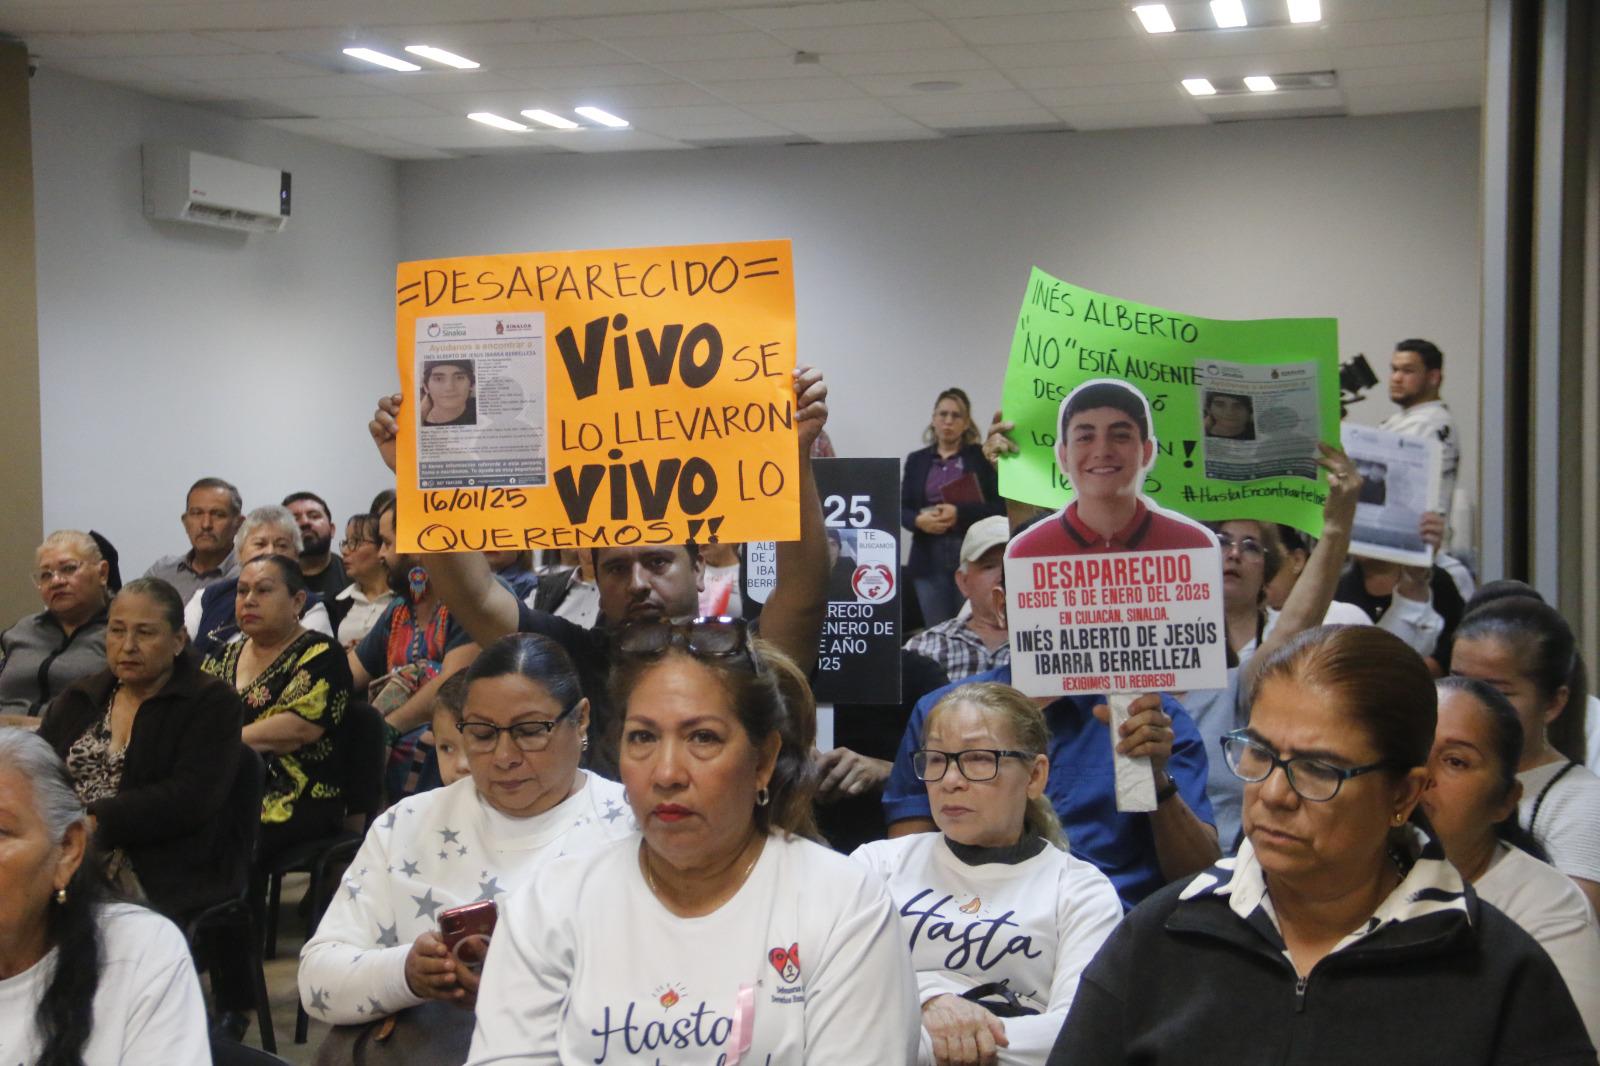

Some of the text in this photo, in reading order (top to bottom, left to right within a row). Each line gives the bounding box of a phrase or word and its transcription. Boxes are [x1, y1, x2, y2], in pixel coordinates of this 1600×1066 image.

[1031, 279, 1199, 343] INÉS ALBERTO
[732, 342, 784, 382] SE
[1078, 348, 1121, 375] ESTÁ
[1124, 356, 1204, 387] AUSENTE
[561, 419, 604, 451] LO
[614, 400, 793, 446] LLEVARON
[737, 459, 785, 502] LO
[423, 483, 528, 513] 16/01/25
[756, 541, 776, 551] ALB
[864, 531, 876, 540] TE
[751, 552, 766, 563] DE
[756, 565, 776, 576] IBA
[1032, 554, 1192, 591] DESAPARECIDO
[1018, 583, 1211, 609] DESDE 16 DE ENERO DEL 2025
[826, 604, 874, 618] RECIO
[1059, 612, 1072, 625] EN
[873, 621, 894, 635] DE
[1016, 617, 1218, 653] INÉS ALBERTO DE JESÚS
[830, 636, 868, 654] AÑO
[1034, 647, 1202, 676] IBARRA BERRELLEZA
[1062, 673, 1176, 691] ¡EXIGIMOS TU REGRESO!
[900, 888, 1043, 971] Hasta
[591, 1001, 734, 1065] Hasta
